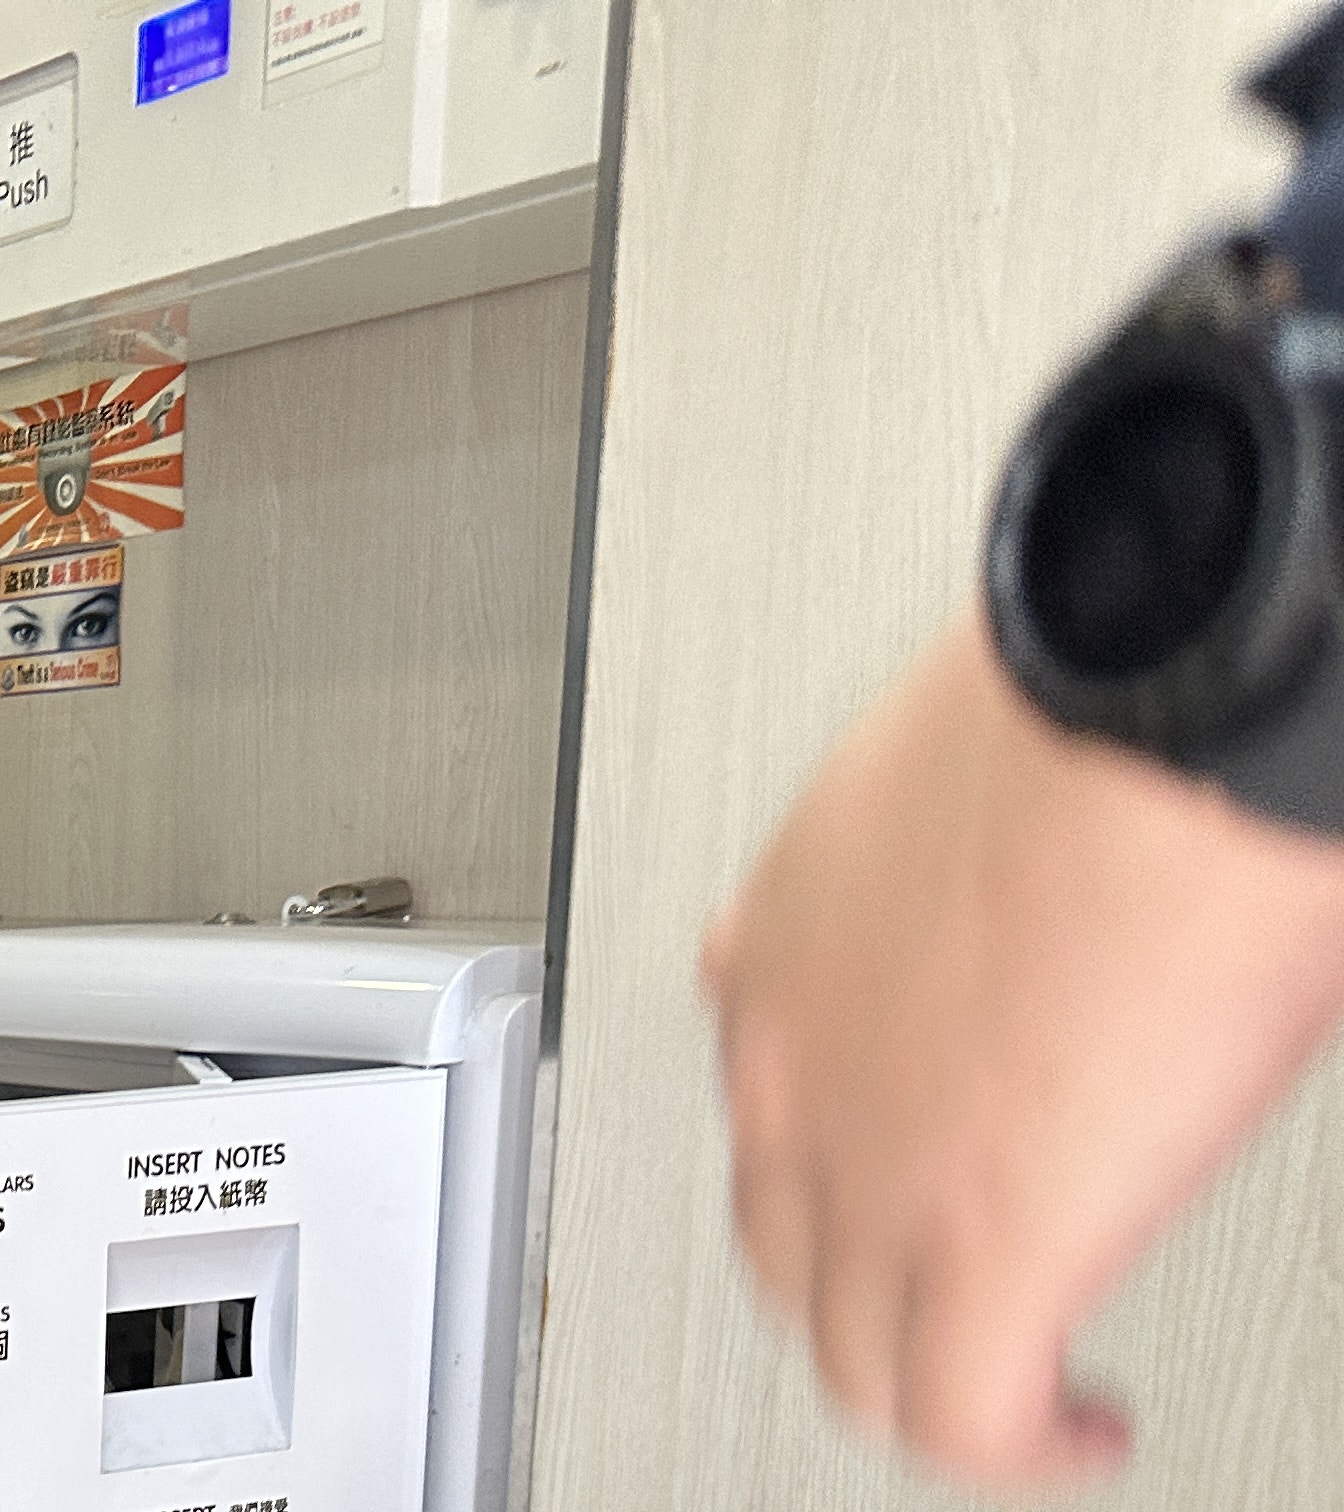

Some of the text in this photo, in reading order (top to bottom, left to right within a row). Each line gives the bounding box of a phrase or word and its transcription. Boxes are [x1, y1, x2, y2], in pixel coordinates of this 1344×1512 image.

[9, 120, 34, 167] 推
[127, 1142, 286, 1180] INSERT NOTES
[143, 1178, 268, 1218] 請投入紙幣
